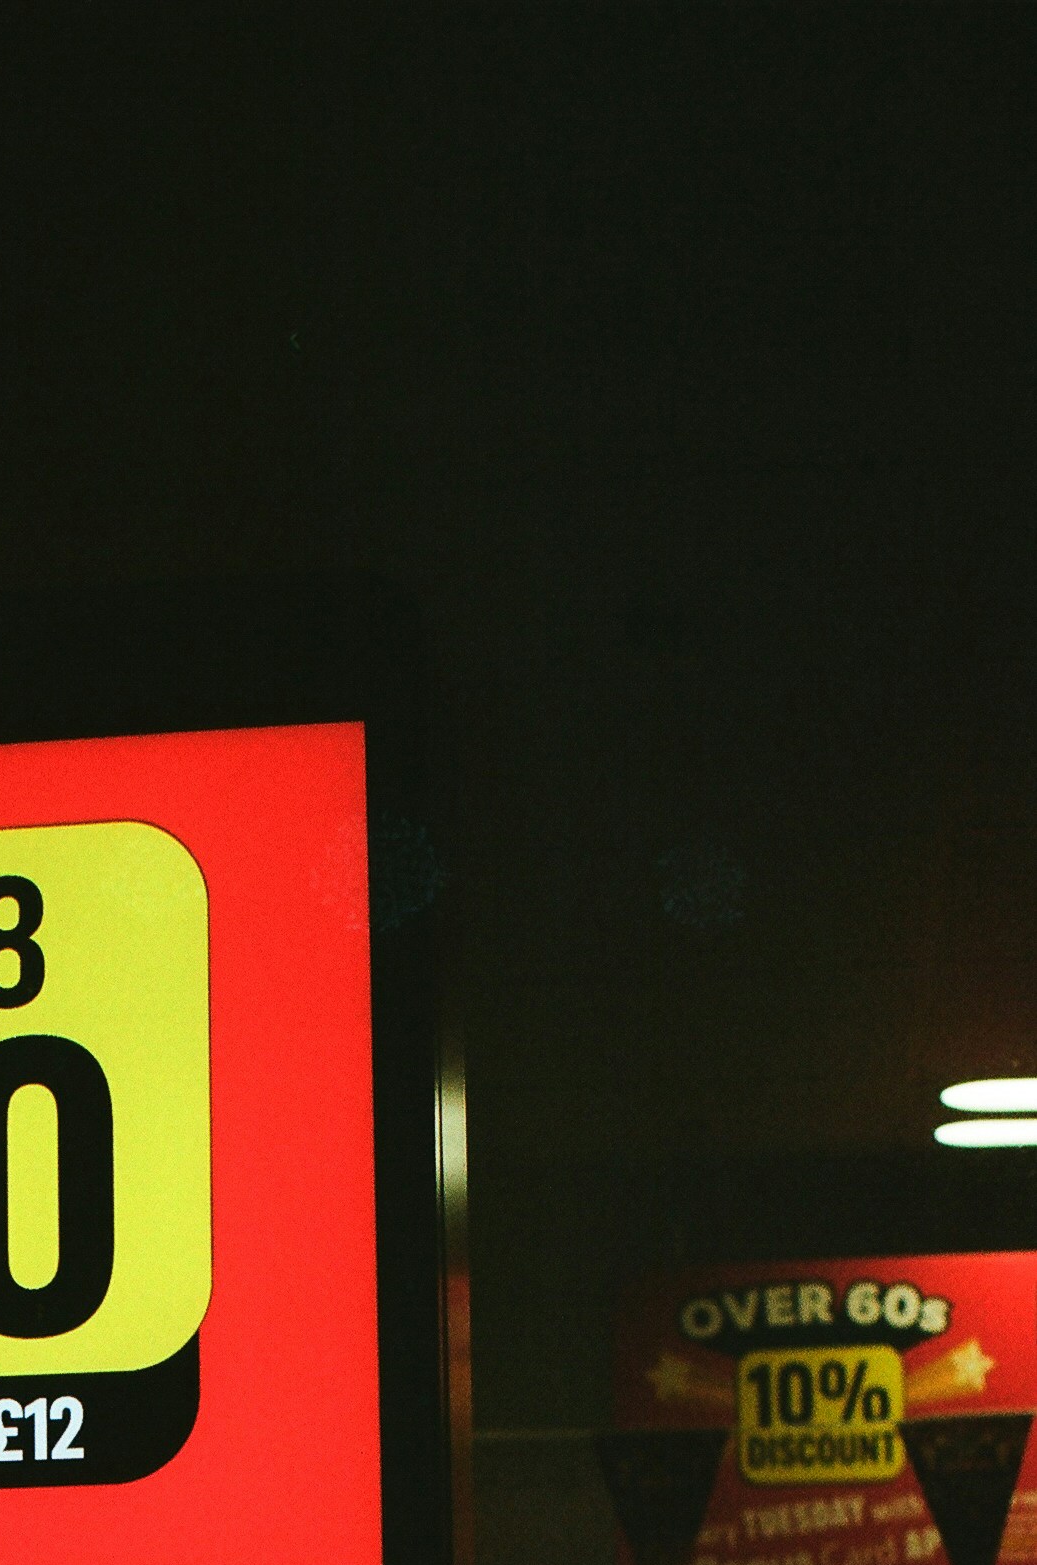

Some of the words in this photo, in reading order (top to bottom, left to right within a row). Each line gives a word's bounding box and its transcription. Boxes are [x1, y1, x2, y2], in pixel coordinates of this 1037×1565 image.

[681, 1282, 833, 1339] OVER
[846, 1281, 950, 1335] 60s
[748, 1360, 891, 1428] 10%
[747, 1431, 895, 1469] DISCOUNT
[740, 1496, 864, 1540] TUESDAY
